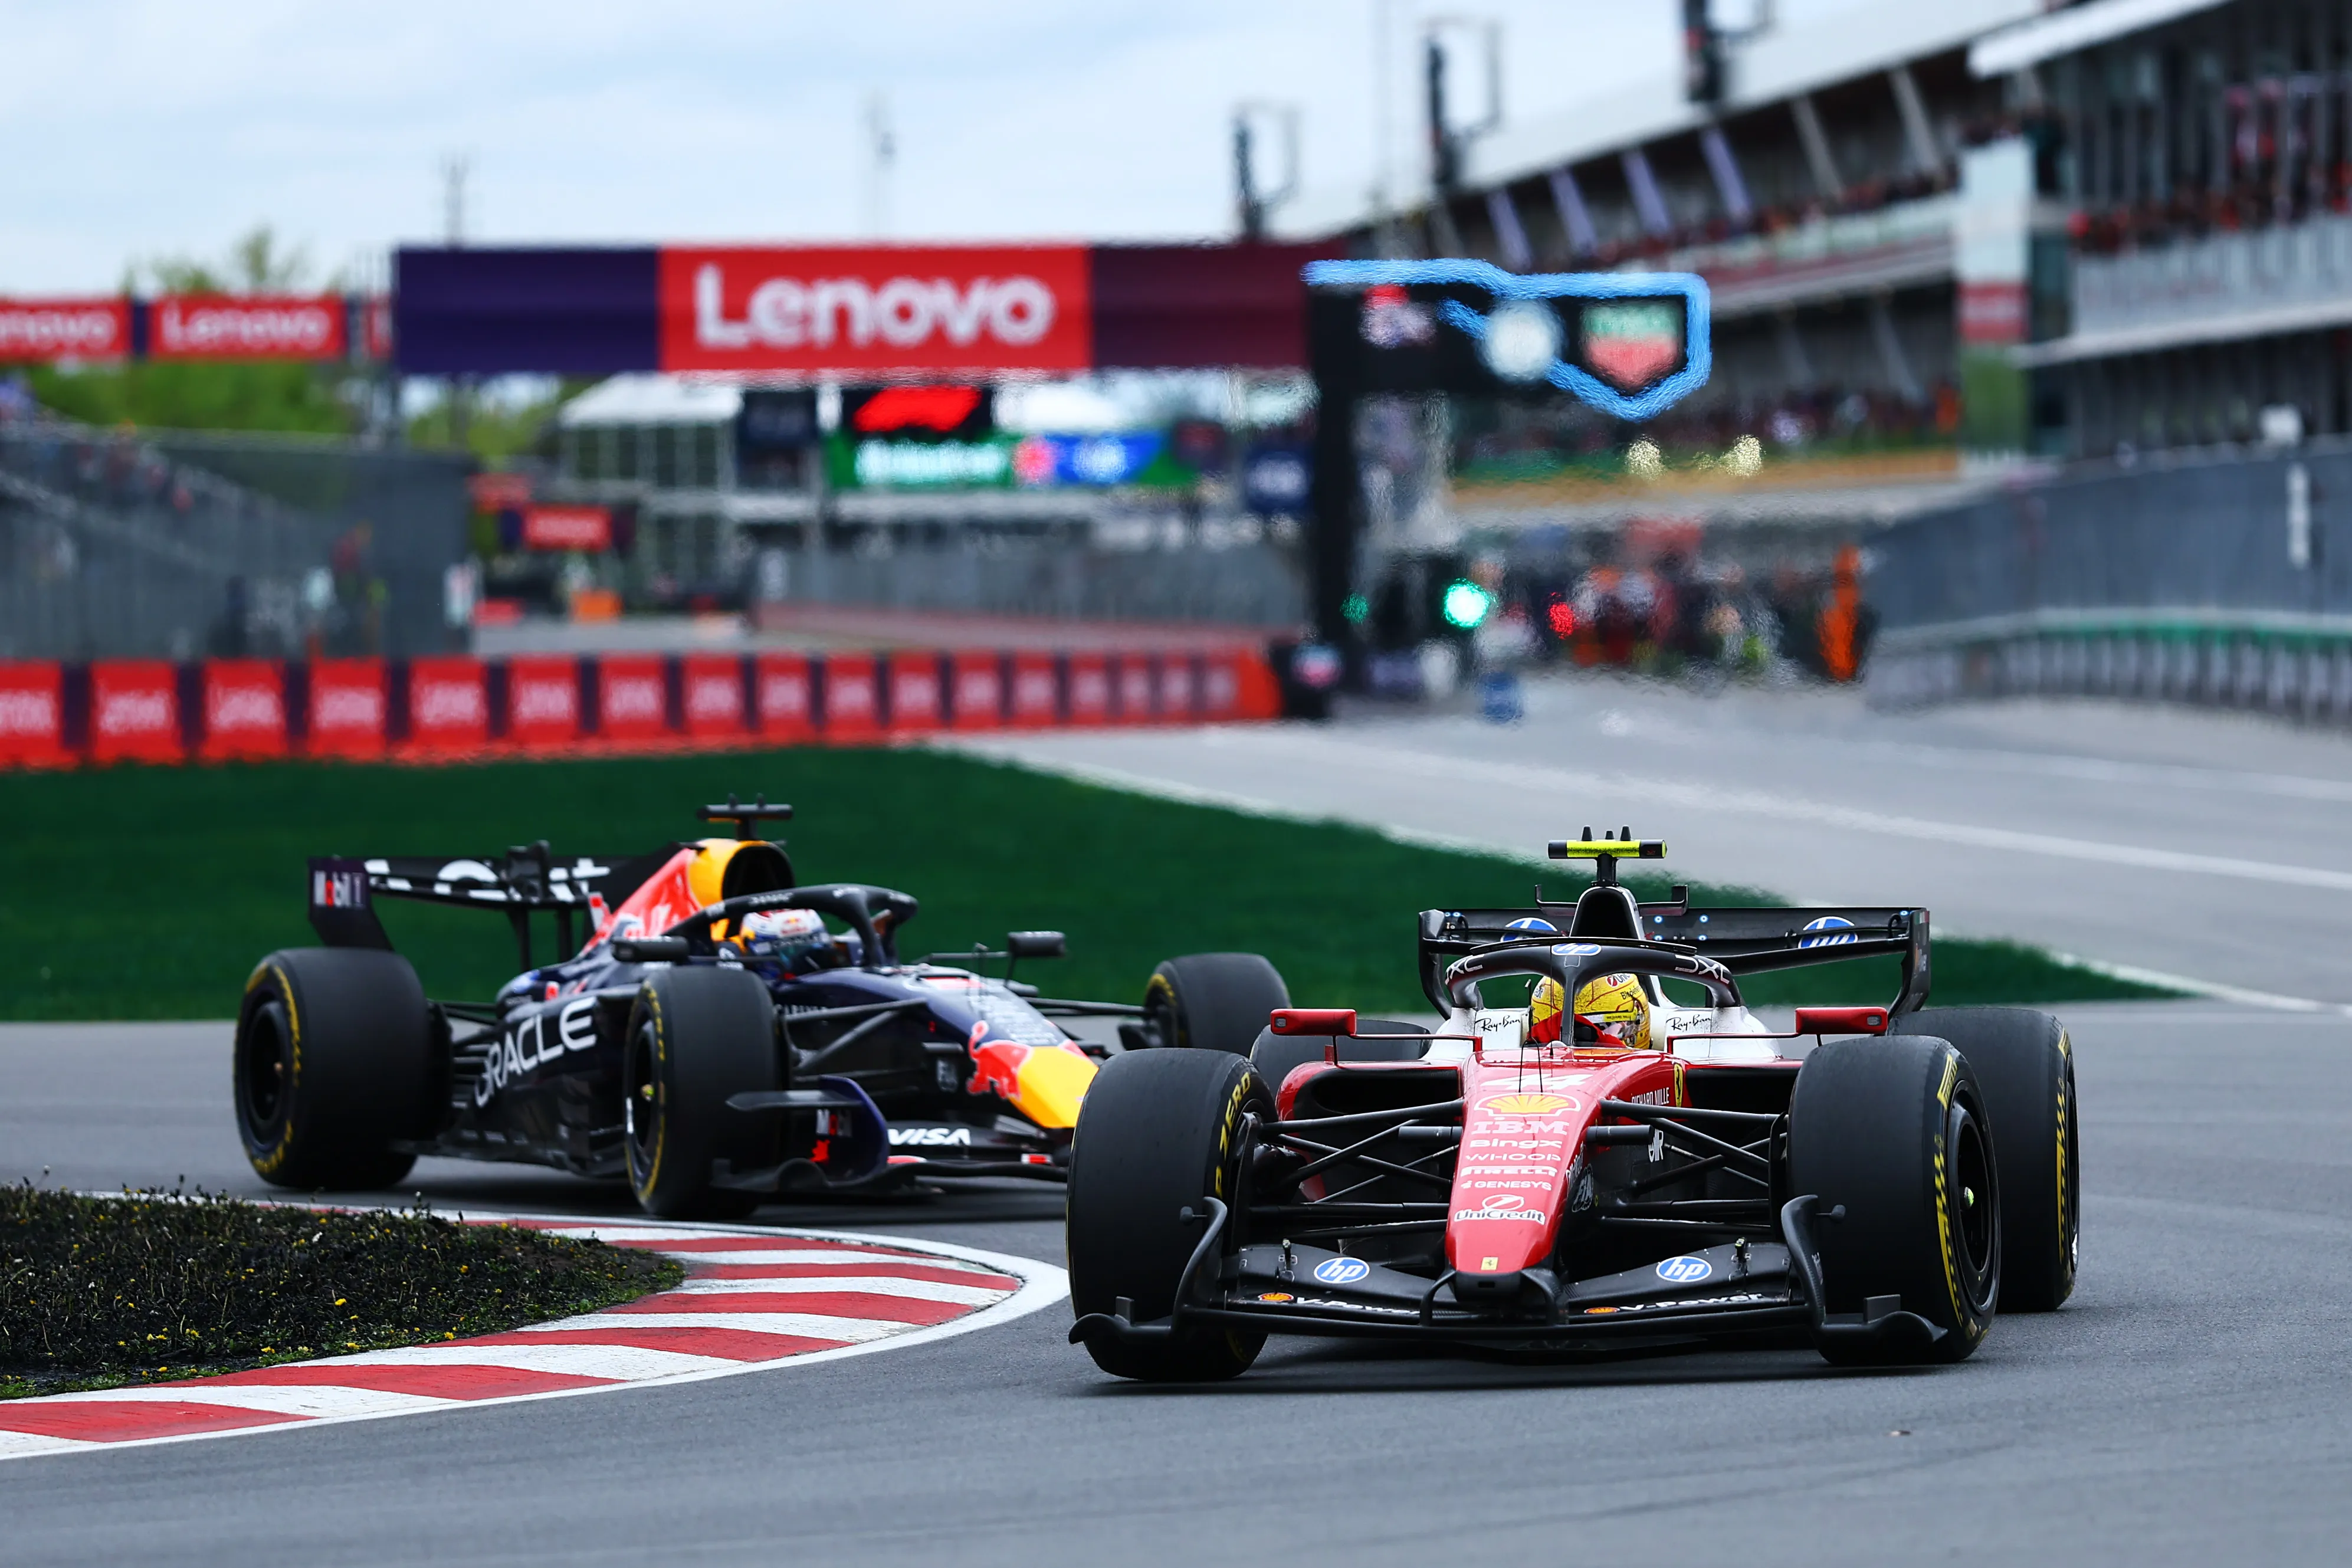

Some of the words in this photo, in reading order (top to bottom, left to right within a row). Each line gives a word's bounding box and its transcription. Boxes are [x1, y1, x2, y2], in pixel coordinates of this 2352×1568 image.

[694, 261, 1057, 347] Lenovo
[162, 297, 331, 350] Lenovo
[1475, 1015, 1520, 1032] Ray-Ban
[1666, 1014, 1711, 1031] Ray-Ban
[475, 996, 597, 1107] ORACLE
[1480, 1074, 1593, 1090] 44
[1655, 1087, 1669, 1106] MILLE
[1220, 1071, 1251, 1162] ZERO
[1471, 1121, 1569, 1136] IBM
[888, 1129, 971, 1146] VISA
[1470, 1138, 1562, 1149] BingX
[1460, 1165, 1557, 1177] PIRELLI
[1475, 1180, 1552, 1191] GENESYS
[1456, 1209, 1546, 1224] UniCredit
[1320, 1258, 1364, 1282] hp
[1664, 1257, 1705, 1281] hp
[1620, 1294, 1762, 1311] V-Power
